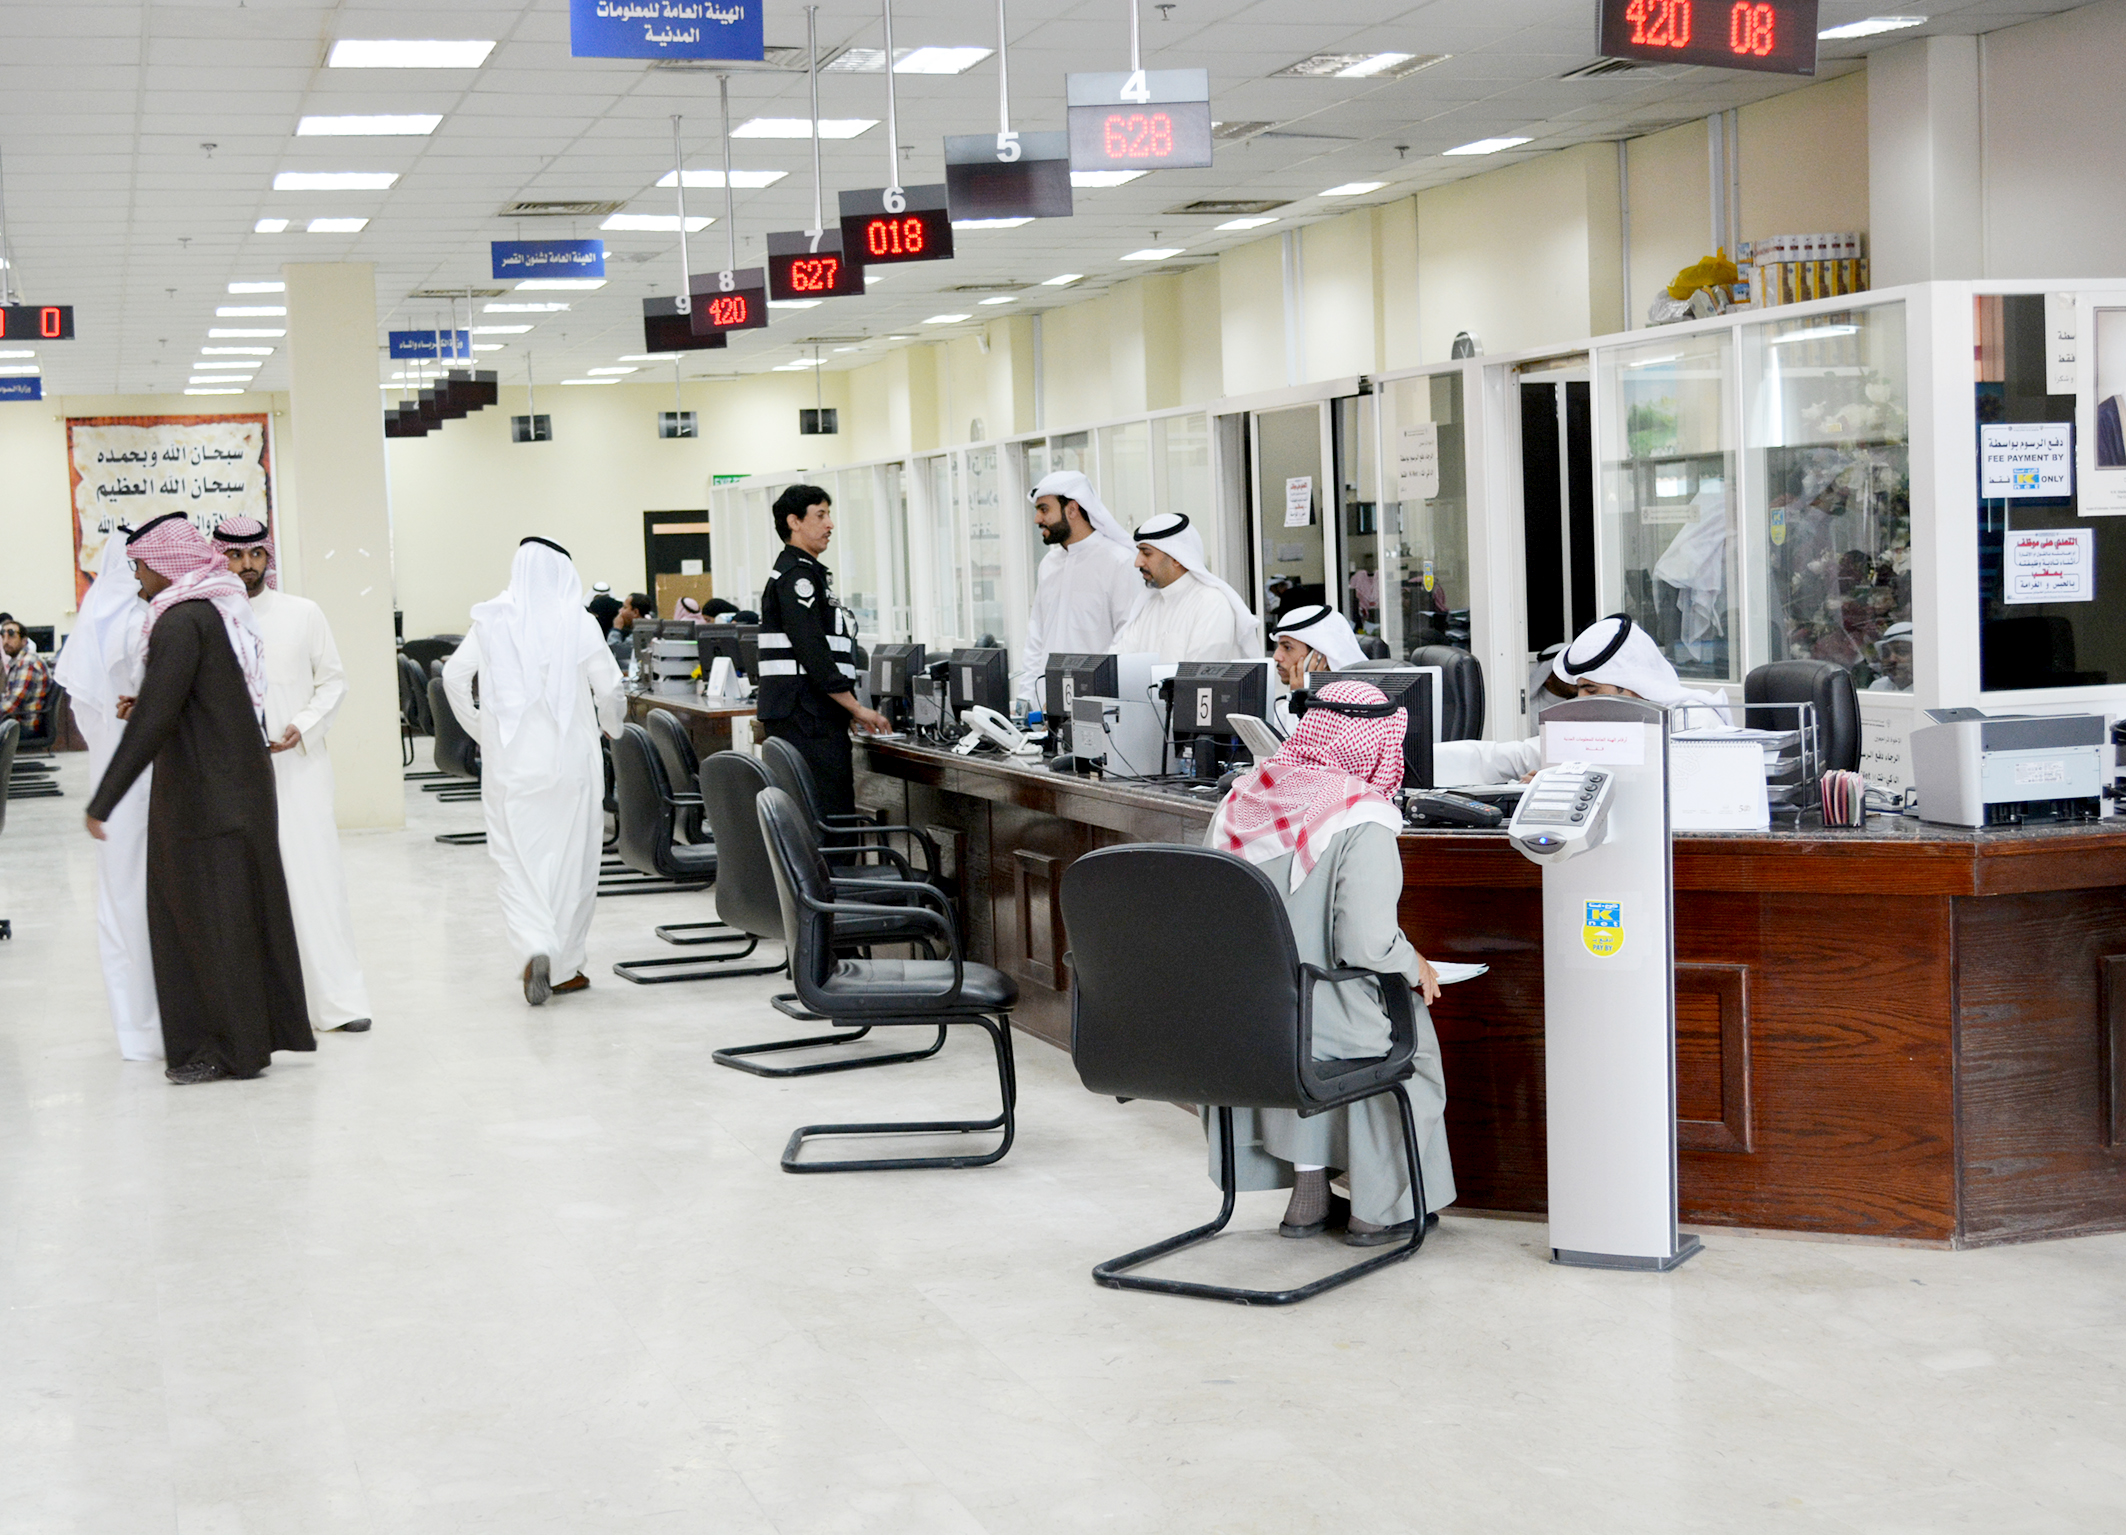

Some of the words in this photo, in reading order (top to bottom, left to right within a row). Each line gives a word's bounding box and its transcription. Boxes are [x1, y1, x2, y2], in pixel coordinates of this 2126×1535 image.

[596, 1, 660, 22] للمعلومات
[663, 1, 703, 19] العامة
[706, 3, 745, 25] الهيئة
[1626, 0, 1691, 48] 420
[1730, 1, 1775, 56] 08
[1120, 70, 1150, 104] 4
[1104, 113, 1173, 158] 628
[996, 132, 1022, 163] 5
[882, 187, 906, 213] 6
[804, 229, 824, 253] 7
[868, 218, 923, 255] 018
[718, 270, 735, 292] 8
[791, 258, 837, 291] 627
[675, 294, 691, 315] 9
[709, 296, 747, 325] 420
[41, 307, 61, 338] 0
[162, 443, 187, 463] الله
[1988, 438, 2019, 451] بواسطة
[2020, 439, 2047, 451] الرسوم
[2047, 437, 2064, 451] دفع
[190, 445, 243, 466] سبحان
[1988, 455, 2005, 463] FEE
[2007, 454, 2049, 462] PAYMENT
[96, 477, 154, 503] العظيم
[159, 474, 185, 495] الله
[190, 476, 245, 499] سبحان
[2041, 475, 2064, 483] ONLY
[1065, 684, 1073, 705] 6
[1200, 695, 1208, 719] 5
